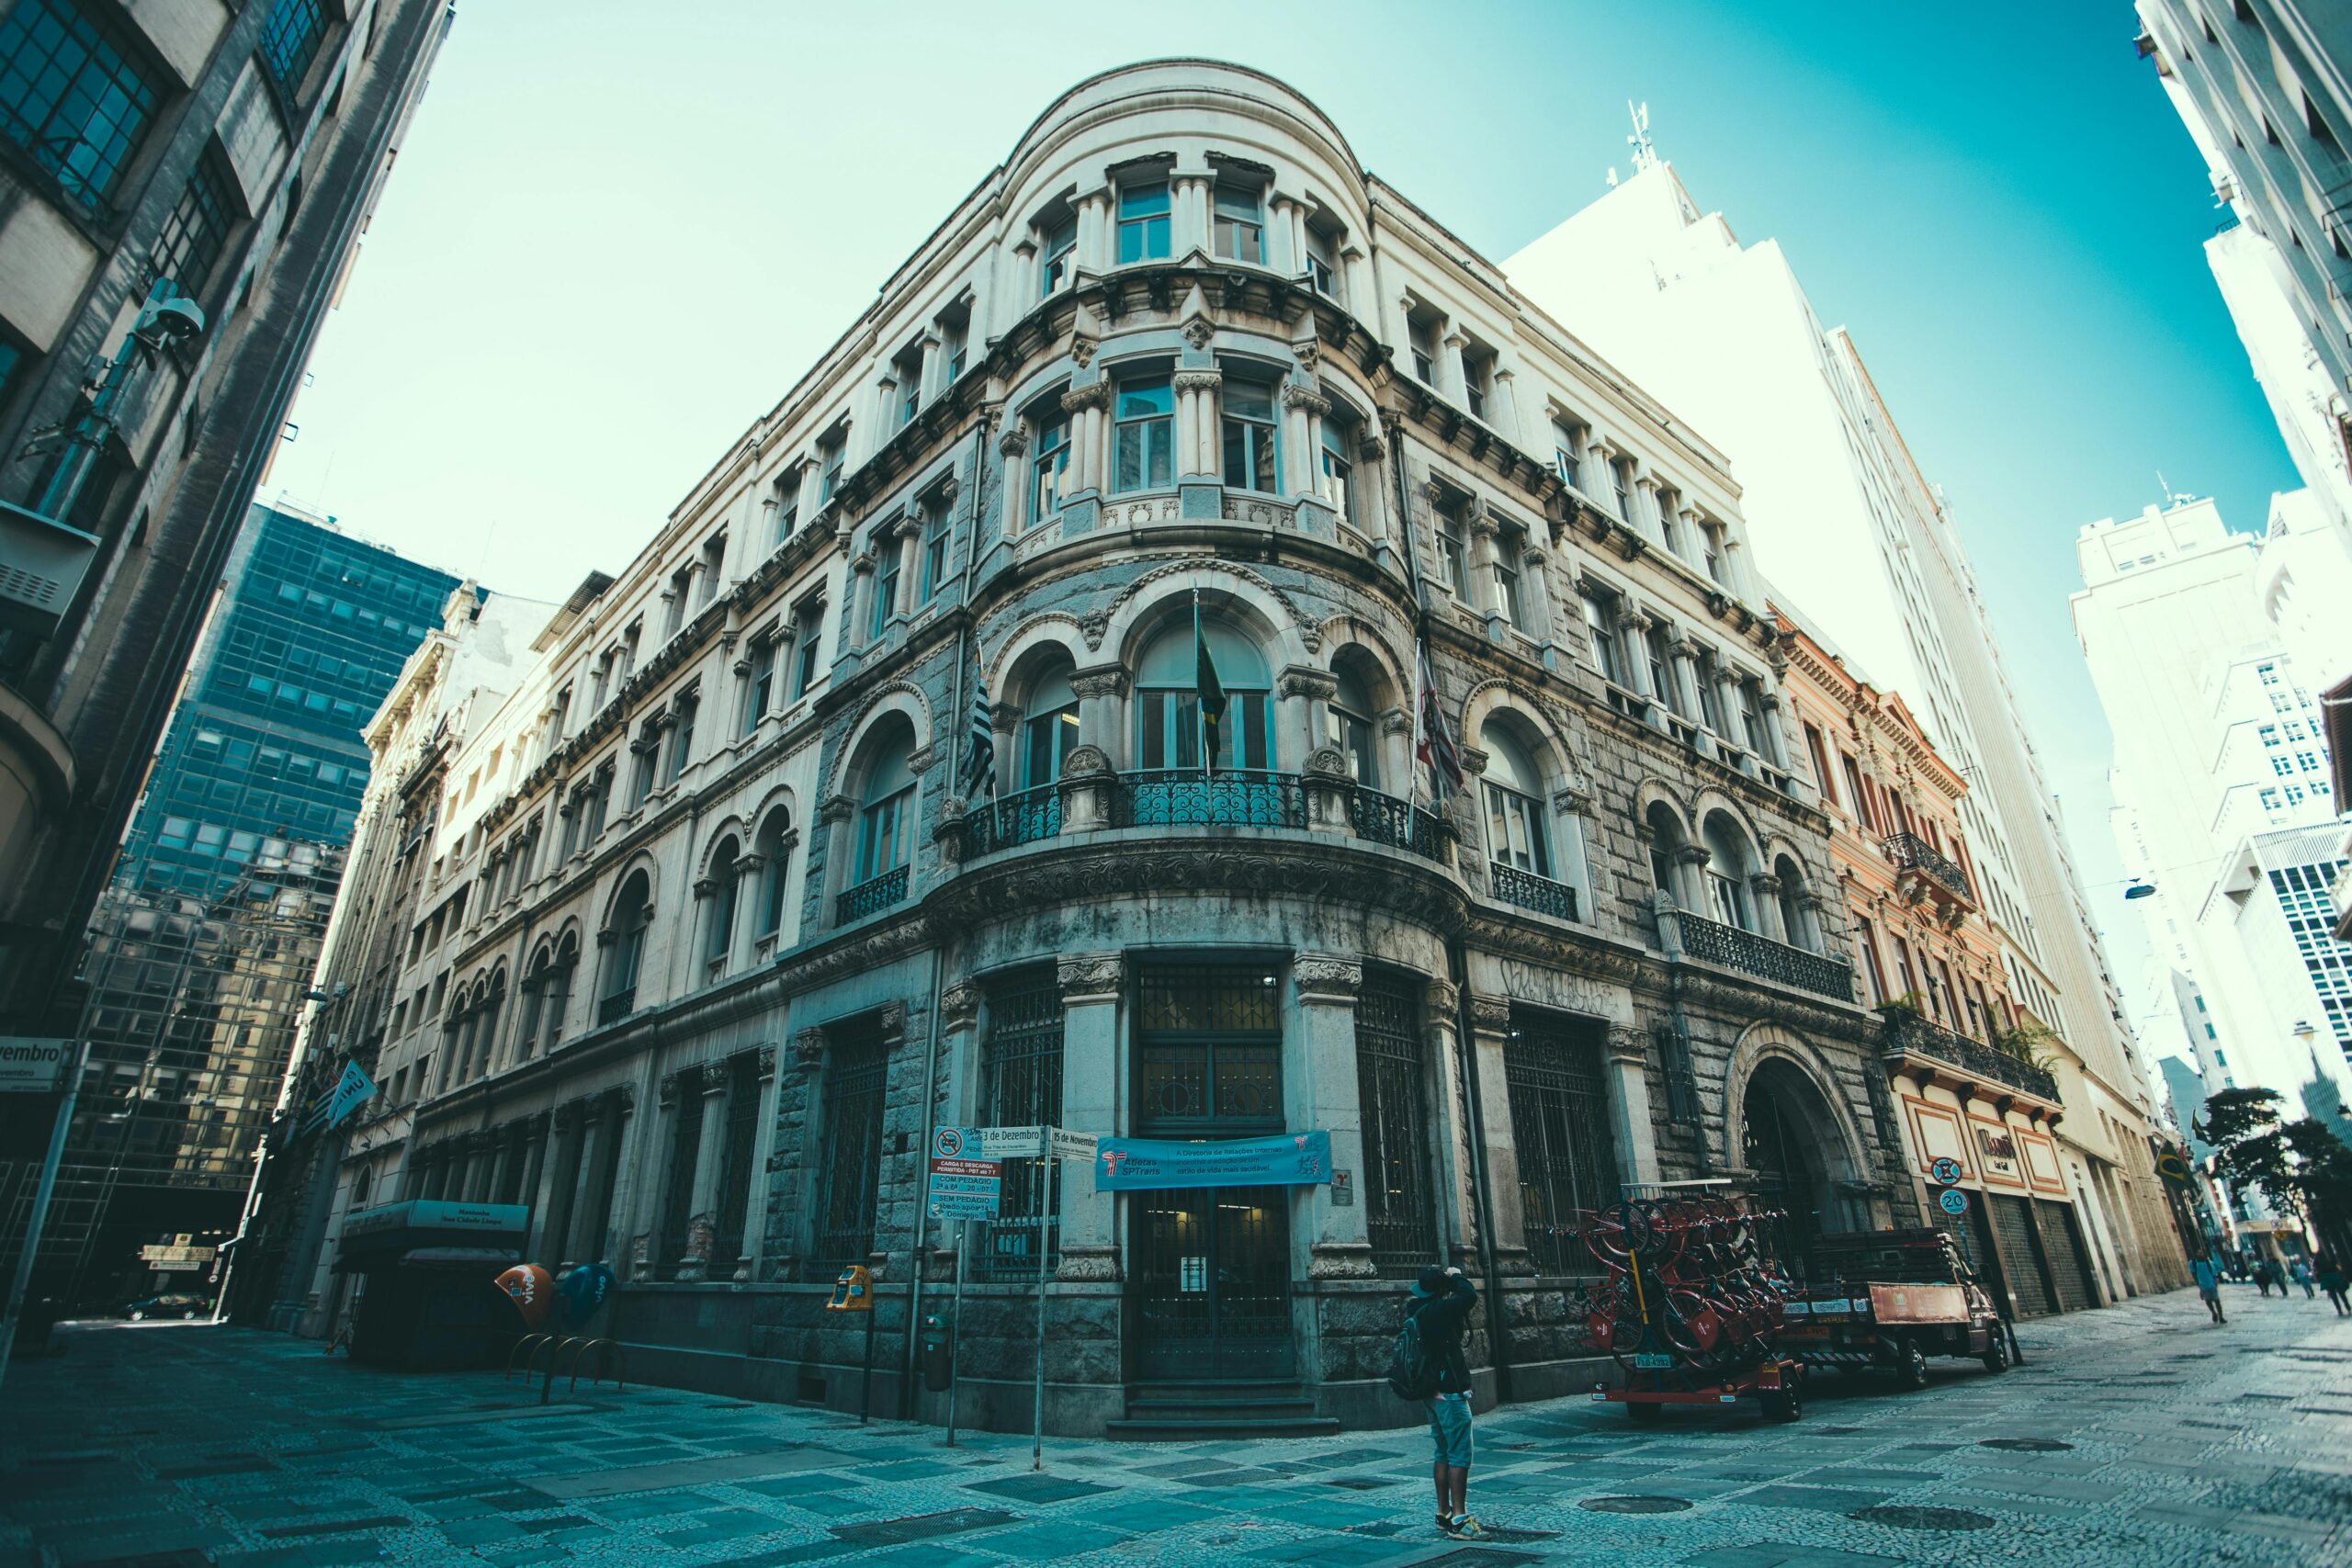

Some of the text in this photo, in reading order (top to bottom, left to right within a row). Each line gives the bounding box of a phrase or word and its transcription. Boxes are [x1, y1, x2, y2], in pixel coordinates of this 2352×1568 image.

[983, 1131, 988, 1141] 3
[989, 1130, 1000, 1141] de
[1001, 1129, 1040, 1141] Dezembro
[1054, 1132, 1098, 1148] 15 de Novembro
[1124, 1157, 1158, 1167] Atletas
[1122, 1167, 1160, 1177] SPTrans
[1943, 1194, 1963, 1208] 20
[947, 1212, 979, 1220] Domingo
[521, 1274, 536, 1305] vivo
[594, 1275, 607, 1304] vivo
